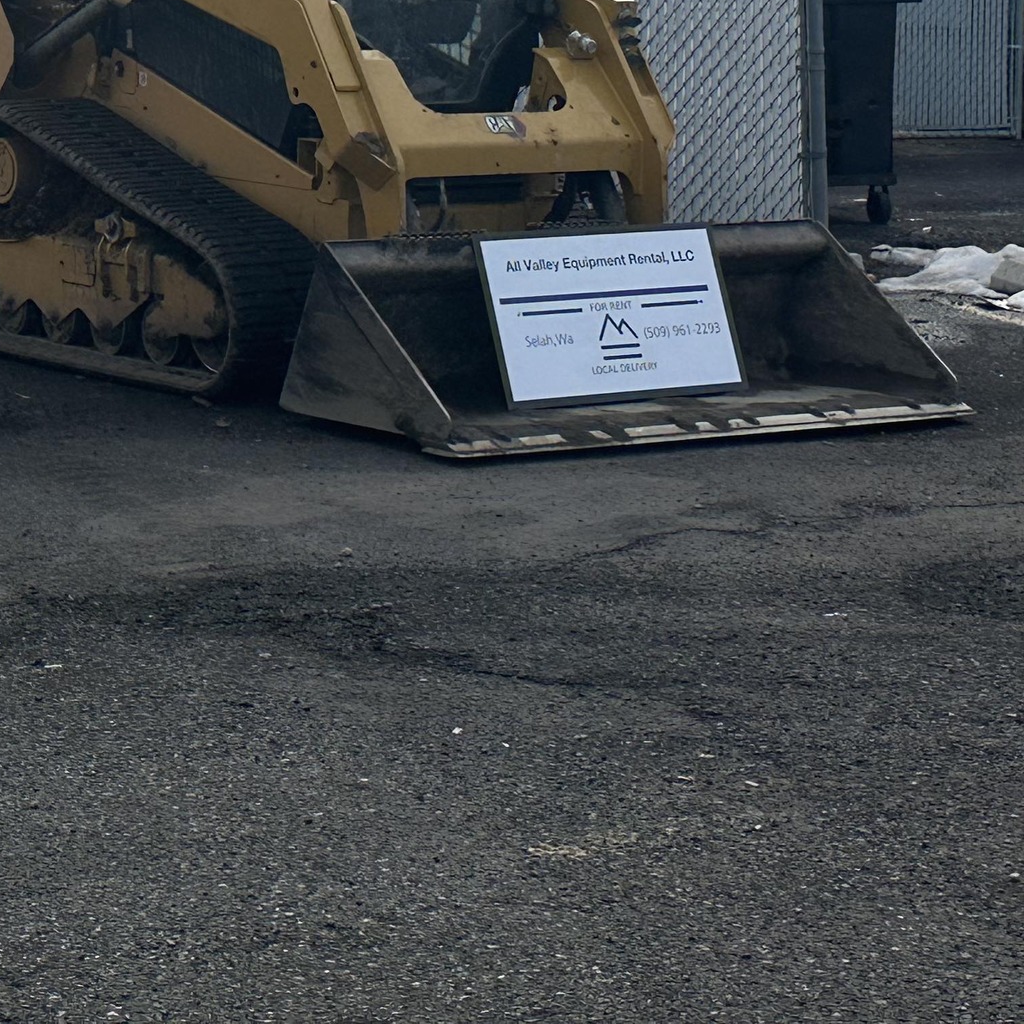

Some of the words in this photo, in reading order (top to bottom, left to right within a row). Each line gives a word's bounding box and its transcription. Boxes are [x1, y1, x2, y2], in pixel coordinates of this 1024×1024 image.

[484, 114, 518, 136] CAT
[506, 260, 522, 273] All
[523, 258, 559, 273] Valley
[562, 255, 627, 271] Equipment
[628, 251, 670, 265] Rental,
[670, 249, 695, 262] LLC
[589, 302, 608, 312] FOR
[609, 300, 632, 311] RENT
[643, 325, 671, 339] (509)
[672, 321, 721, 337] 961-2293
[592, 364, 618, 375] LOCAL
[619, 361, 658, 373] DELIVERY
